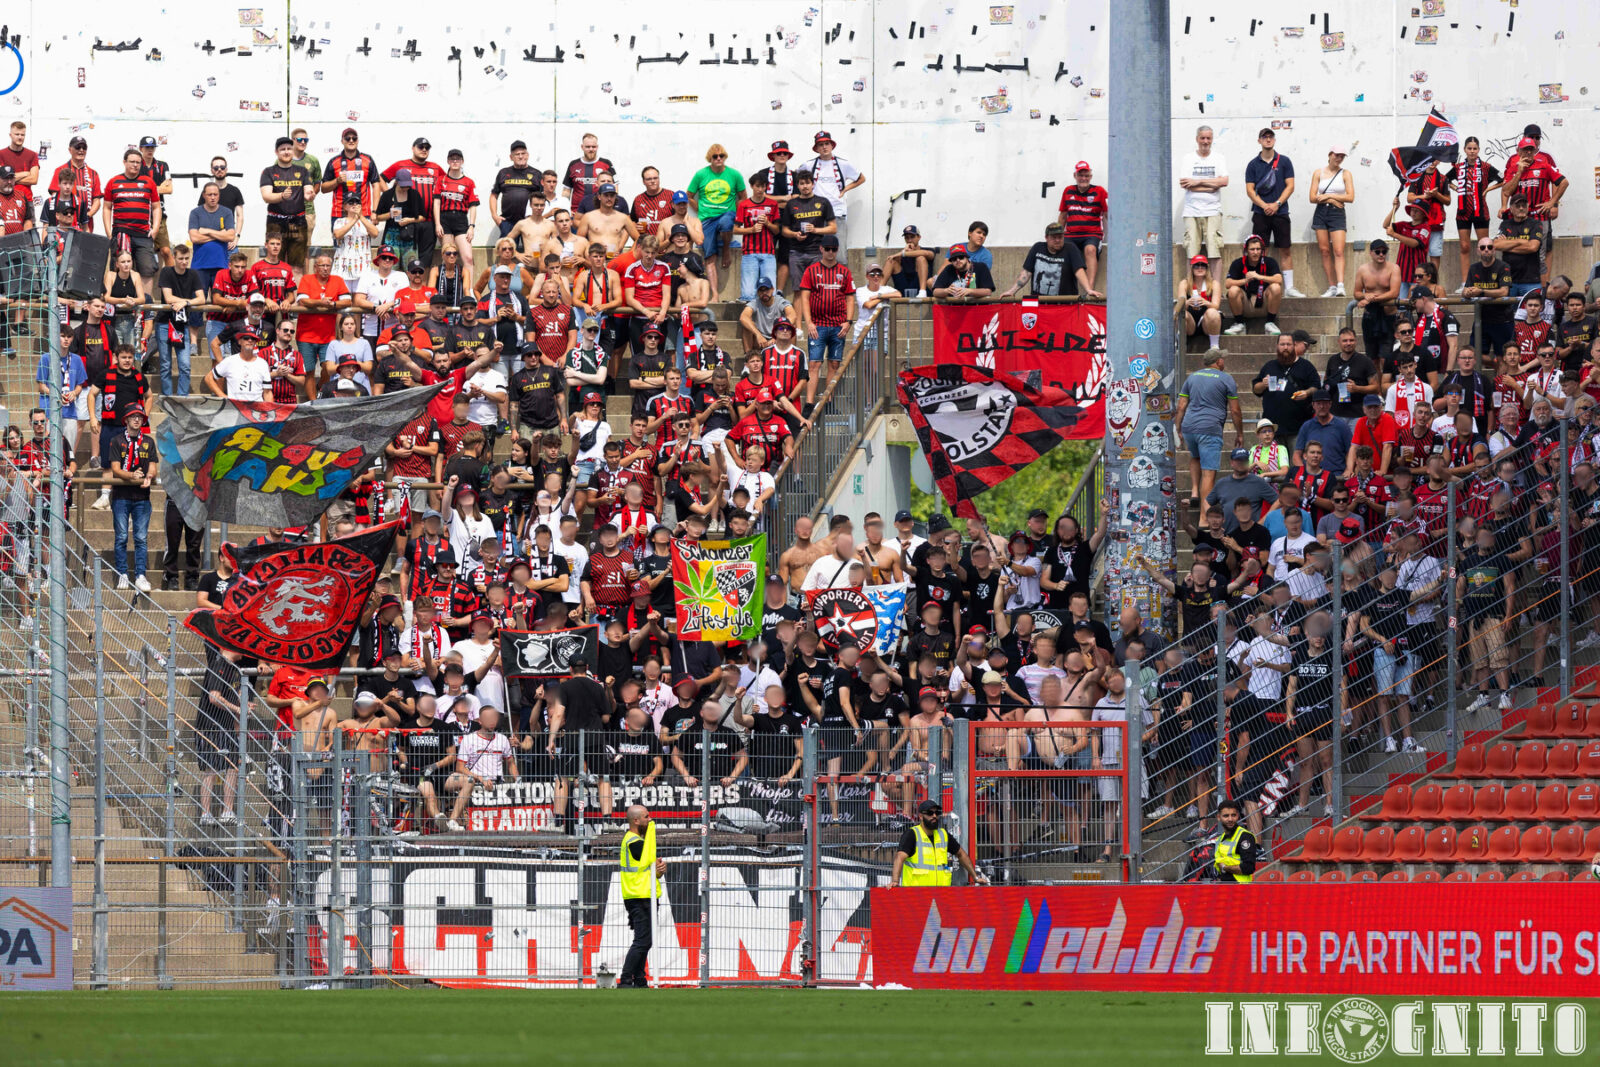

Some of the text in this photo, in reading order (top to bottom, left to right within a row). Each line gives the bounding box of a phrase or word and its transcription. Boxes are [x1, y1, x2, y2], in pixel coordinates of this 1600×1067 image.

[675, 540, 752, 562] Schanzer
[814, 590, 869, 616] SUPPORTERS
[1250, 920, 1600, 976] IHR PARTNER FÜR S
